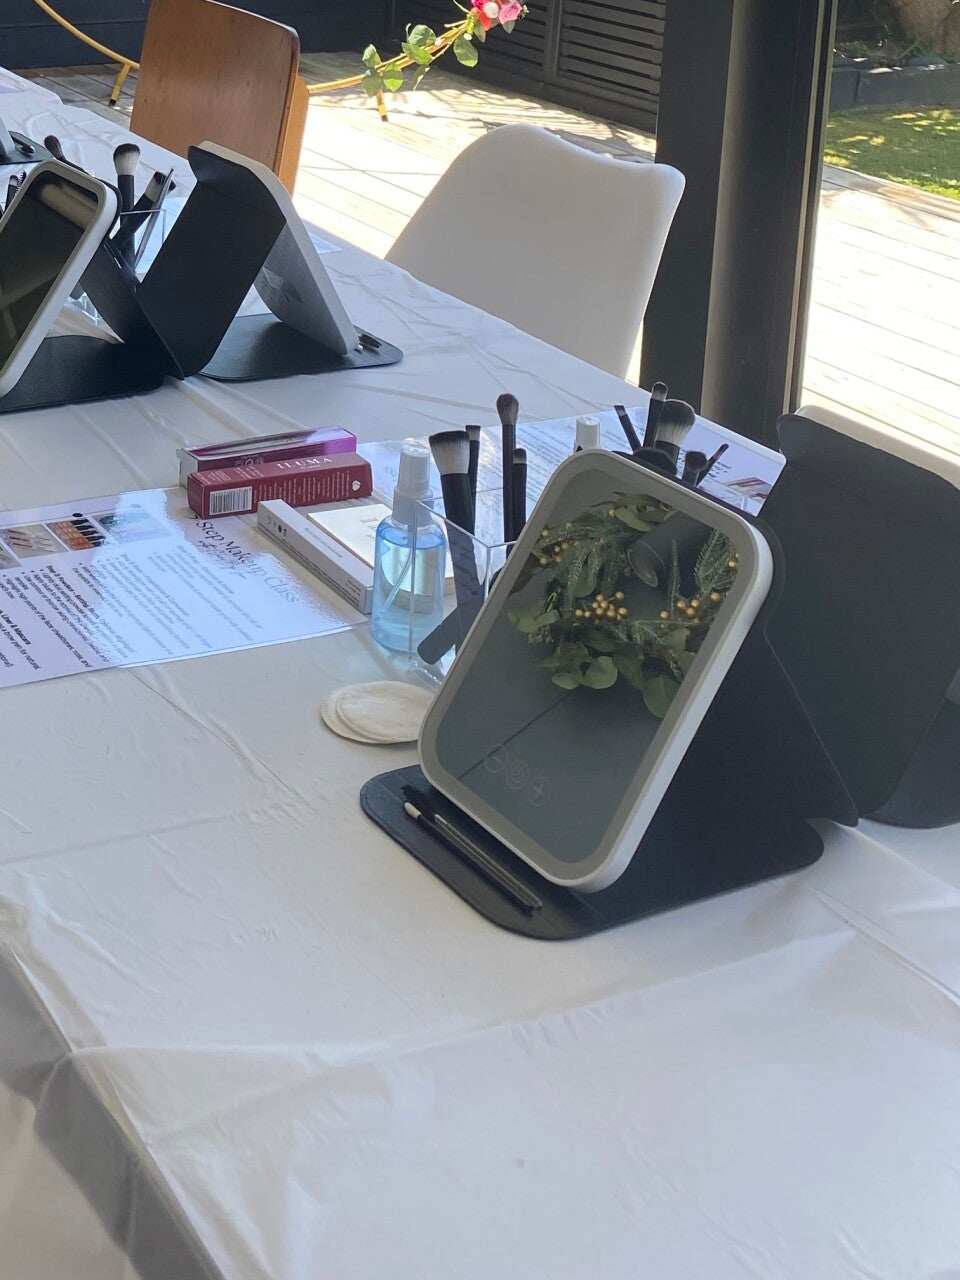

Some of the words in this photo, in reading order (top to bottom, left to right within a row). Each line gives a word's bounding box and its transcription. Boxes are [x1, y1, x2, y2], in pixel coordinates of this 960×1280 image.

[277, 457, 333, 470] ILUMA
[223, 541, 267, 577] Makeup
[264, 576, 300, 603] Class
